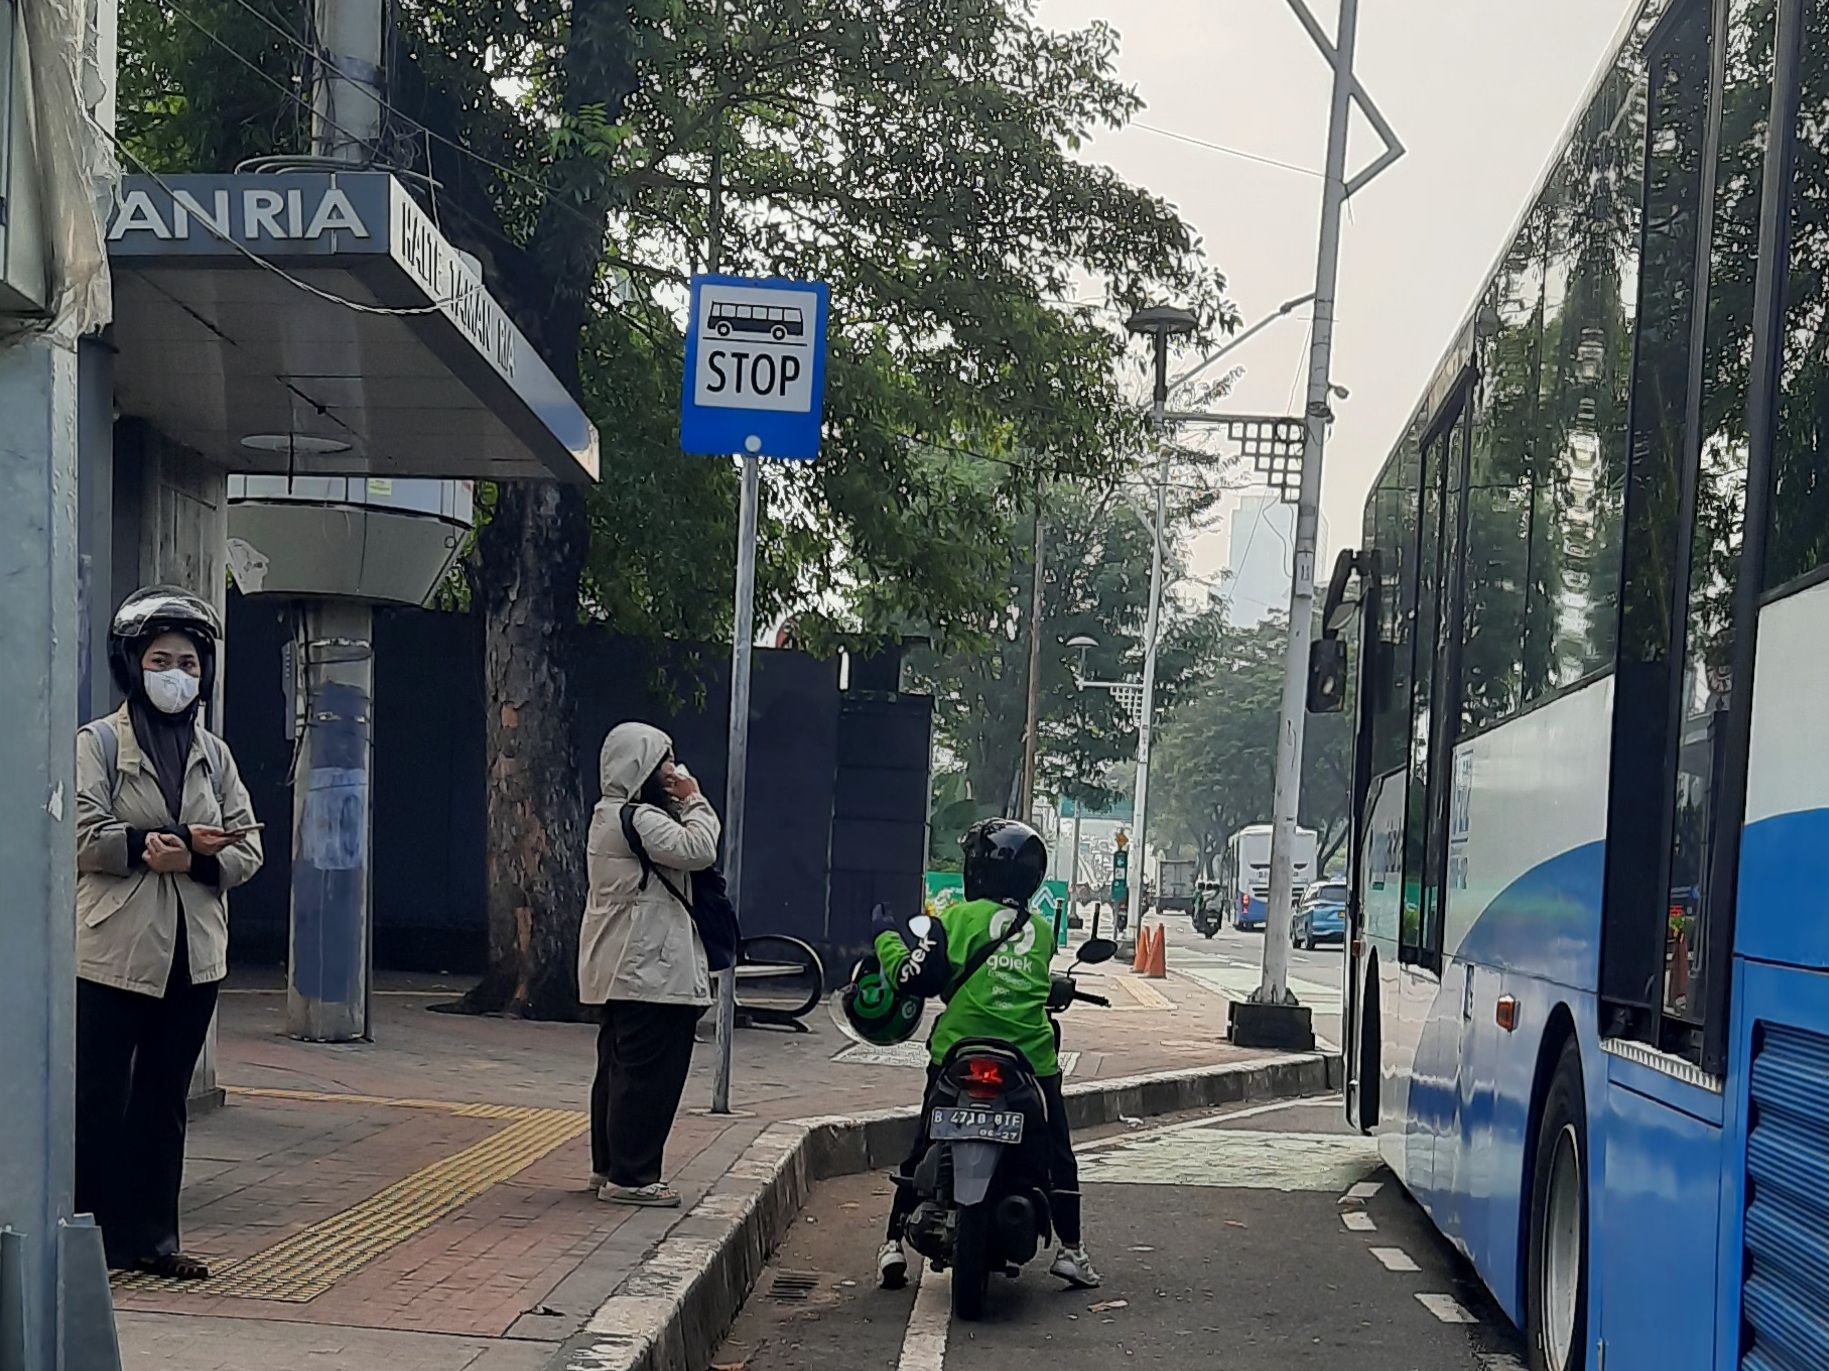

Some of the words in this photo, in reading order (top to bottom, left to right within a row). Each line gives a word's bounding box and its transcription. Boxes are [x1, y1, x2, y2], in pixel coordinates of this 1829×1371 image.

[243, 189, 370, 239] RIA
[402, 202, 442, 297] HALTE
[449, 260, 491, 352] TAMAN
[497, 318, 514, 378] RIA
[706, 350, 800, 396] STOP
[986, 954, 1032, 973] gojek
[934, 1111, 942, 1122] B
